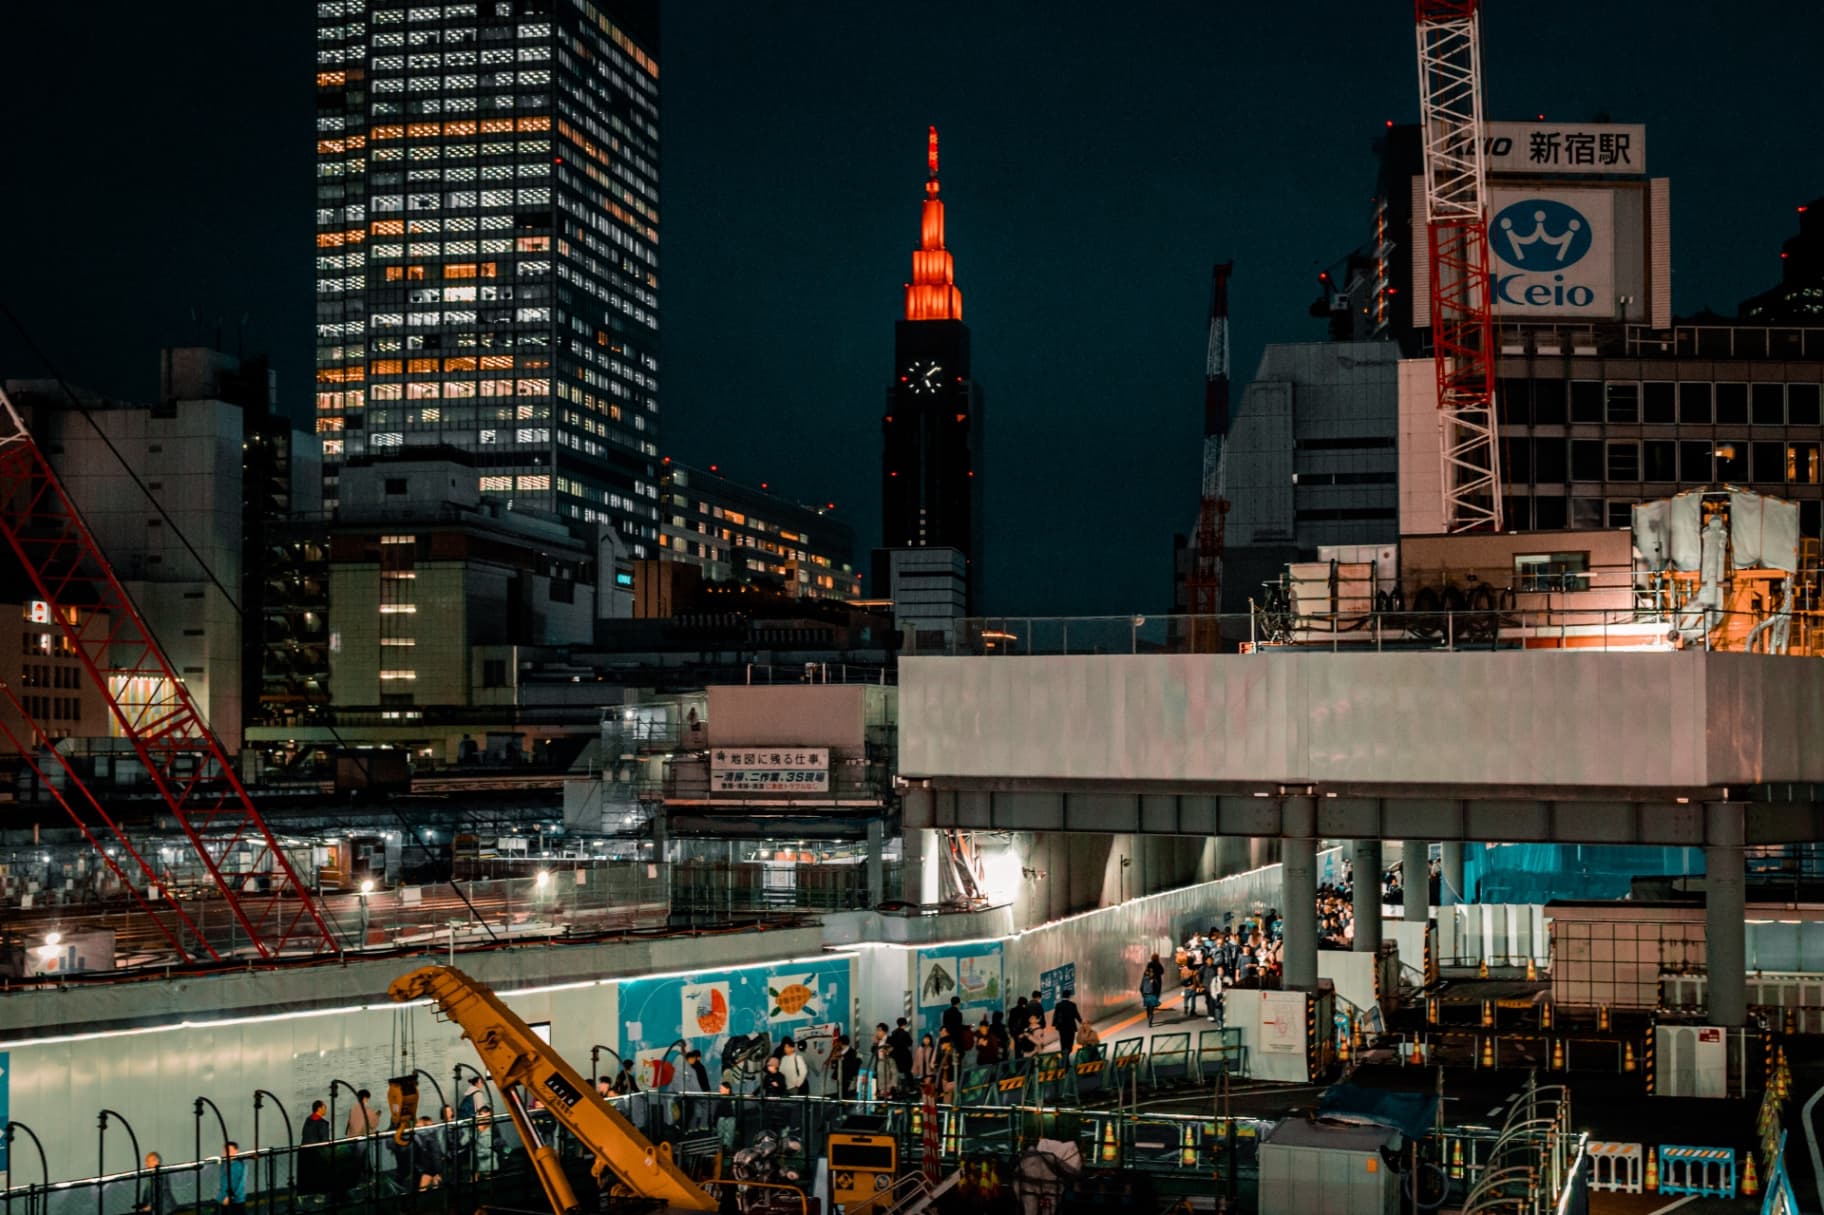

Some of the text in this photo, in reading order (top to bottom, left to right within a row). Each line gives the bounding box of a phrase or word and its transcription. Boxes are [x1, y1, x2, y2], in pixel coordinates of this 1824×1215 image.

[1529, 131, 1631, 165] 新宿駅
[1489, 273, 1594, 307] Keio
